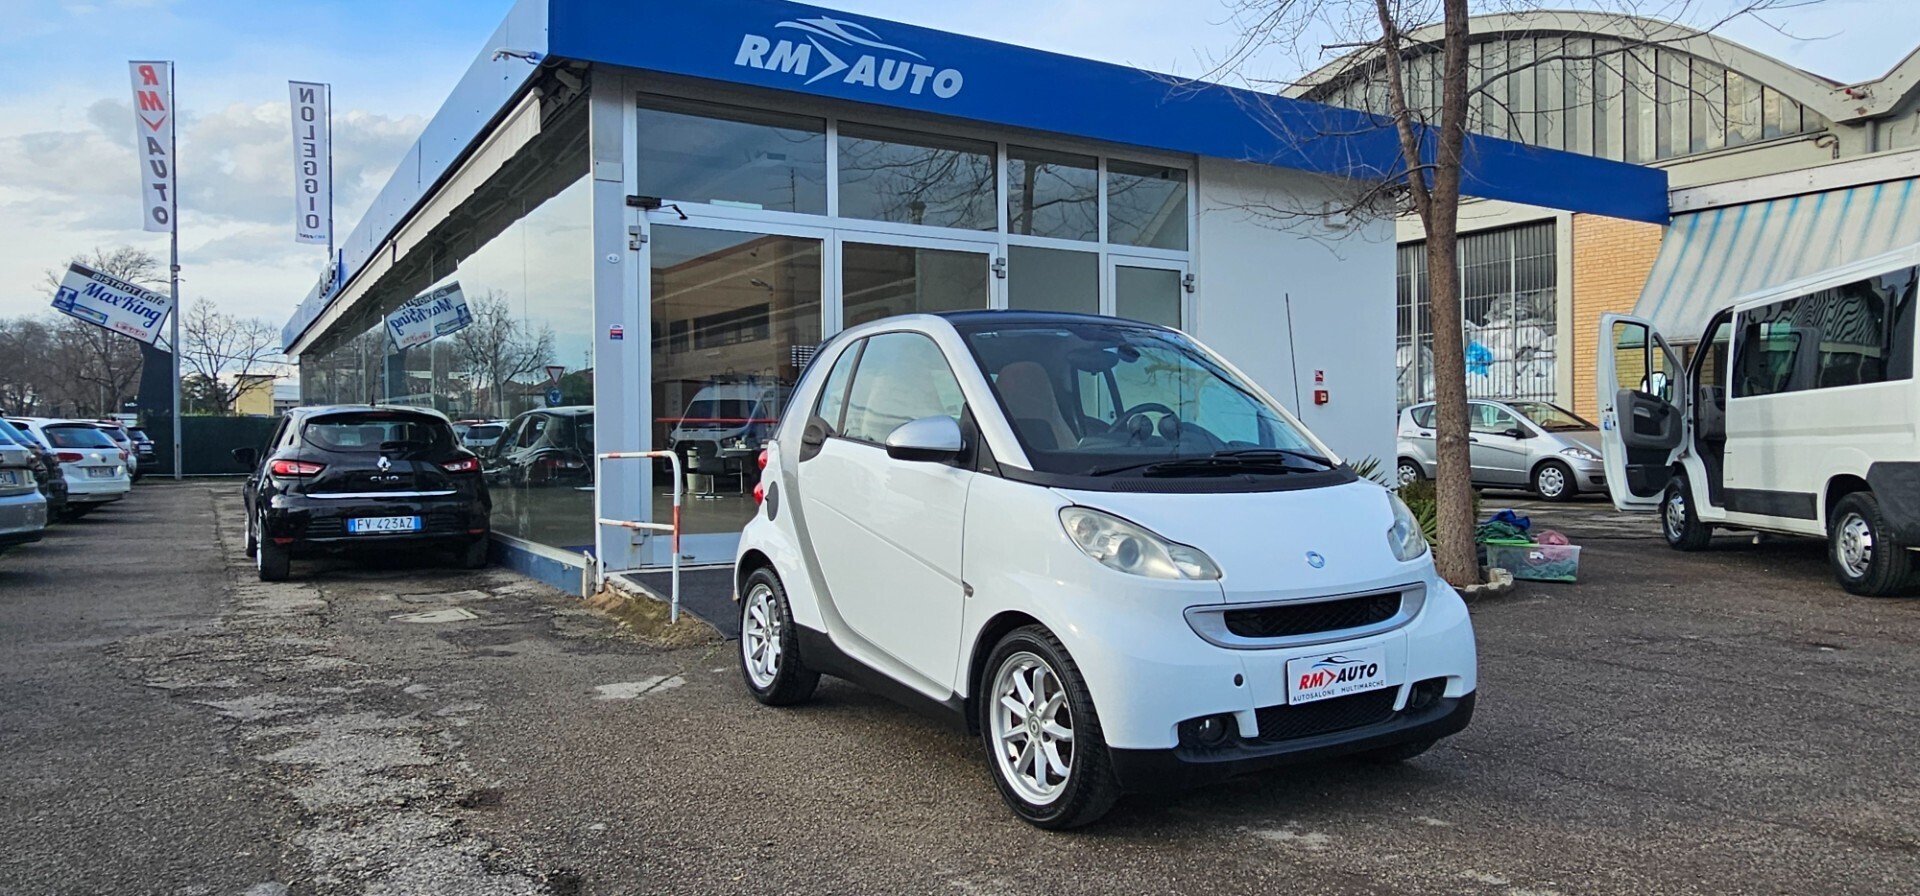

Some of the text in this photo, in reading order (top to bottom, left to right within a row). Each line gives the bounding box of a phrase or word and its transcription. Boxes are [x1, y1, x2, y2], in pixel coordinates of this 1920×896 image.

[843, 54, 963, 99] AUTO
[91, 272, 139, 296] BISTROT
[357, 517, 413, 530] FV 423AZ
[1335, 663, 1378, 684] AUTO
[1292, 680, 1384, 702] AUTOSALONE MULTIMARCHE
